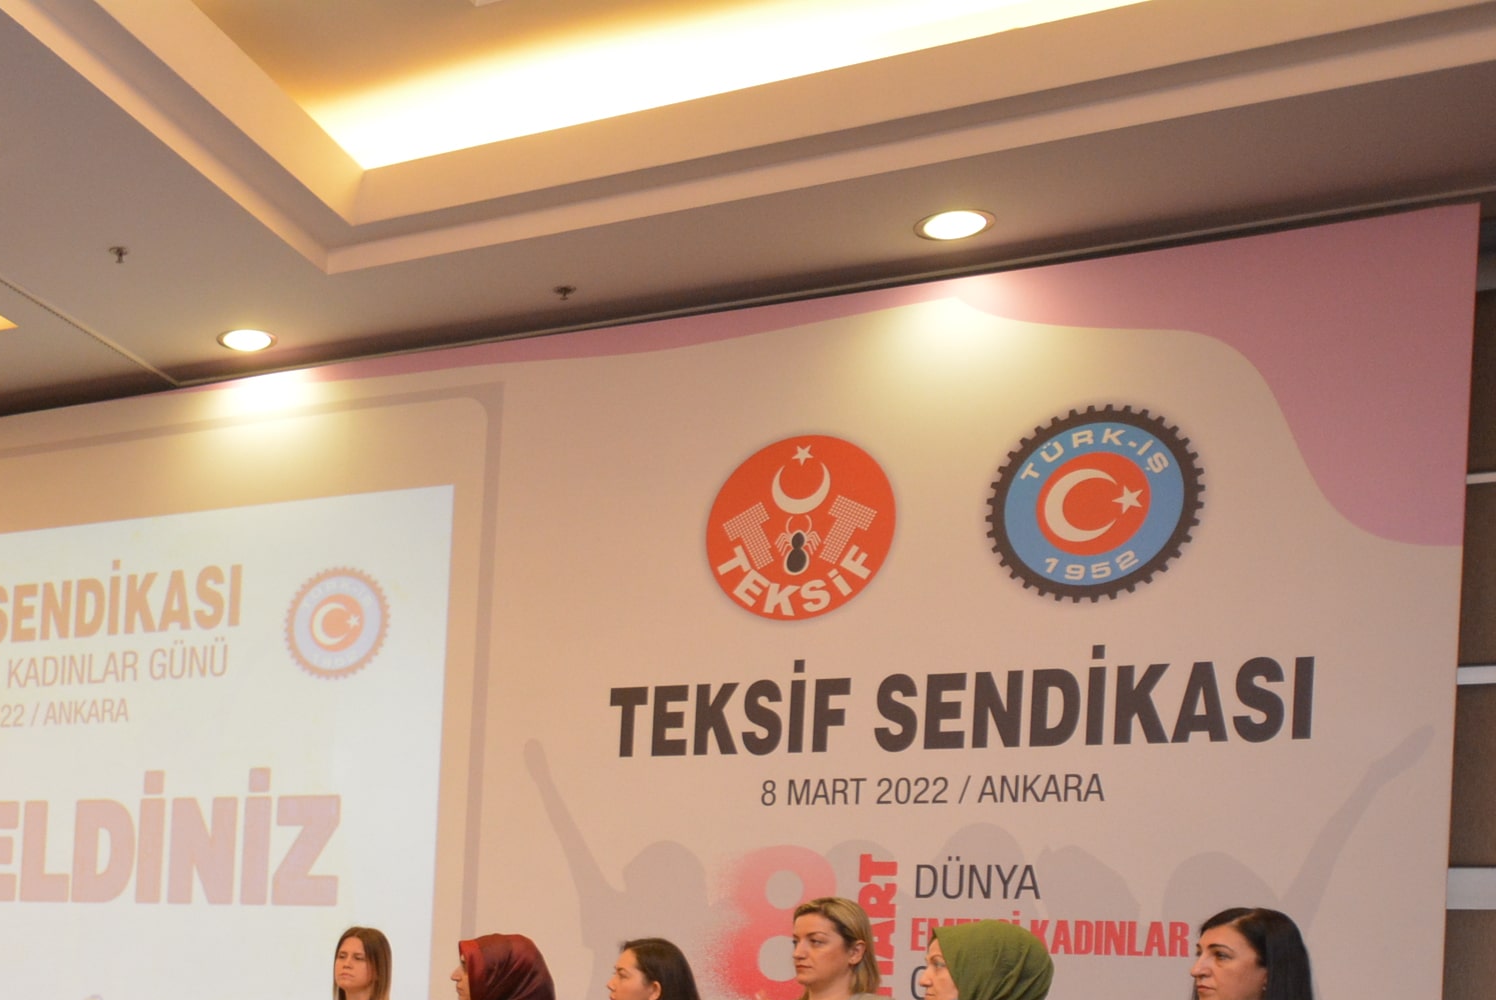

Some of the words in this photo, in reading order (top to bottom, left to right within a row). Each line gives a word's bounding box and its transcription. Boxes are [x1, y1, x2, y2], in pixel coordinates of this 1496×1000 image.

[1020, 427, 1170, 480] TÜRK-İŞ
[717, 545, 871, 616] TEKSİF
[1045, 550, 1139, 580] 1952
[6, 650, 139, 690] KADINLAR
[149, 637, 230, 681] GÜNÜ
[43, 698, 129, 727] ANKARA
[609, 659, 851, 758] TEKSİF
[873, 644, 1315, 753] SENDİKASI
[761, 780, 777, 807] 8
[786, 778, 868, 806] MART
[876, 777, 949, 805] 2022
[977, 773, 1105, 803] ANKARA
[915, 856, 1041, 899] DÜNYA
[1030, 919, 1189, 957] KADINLAR
